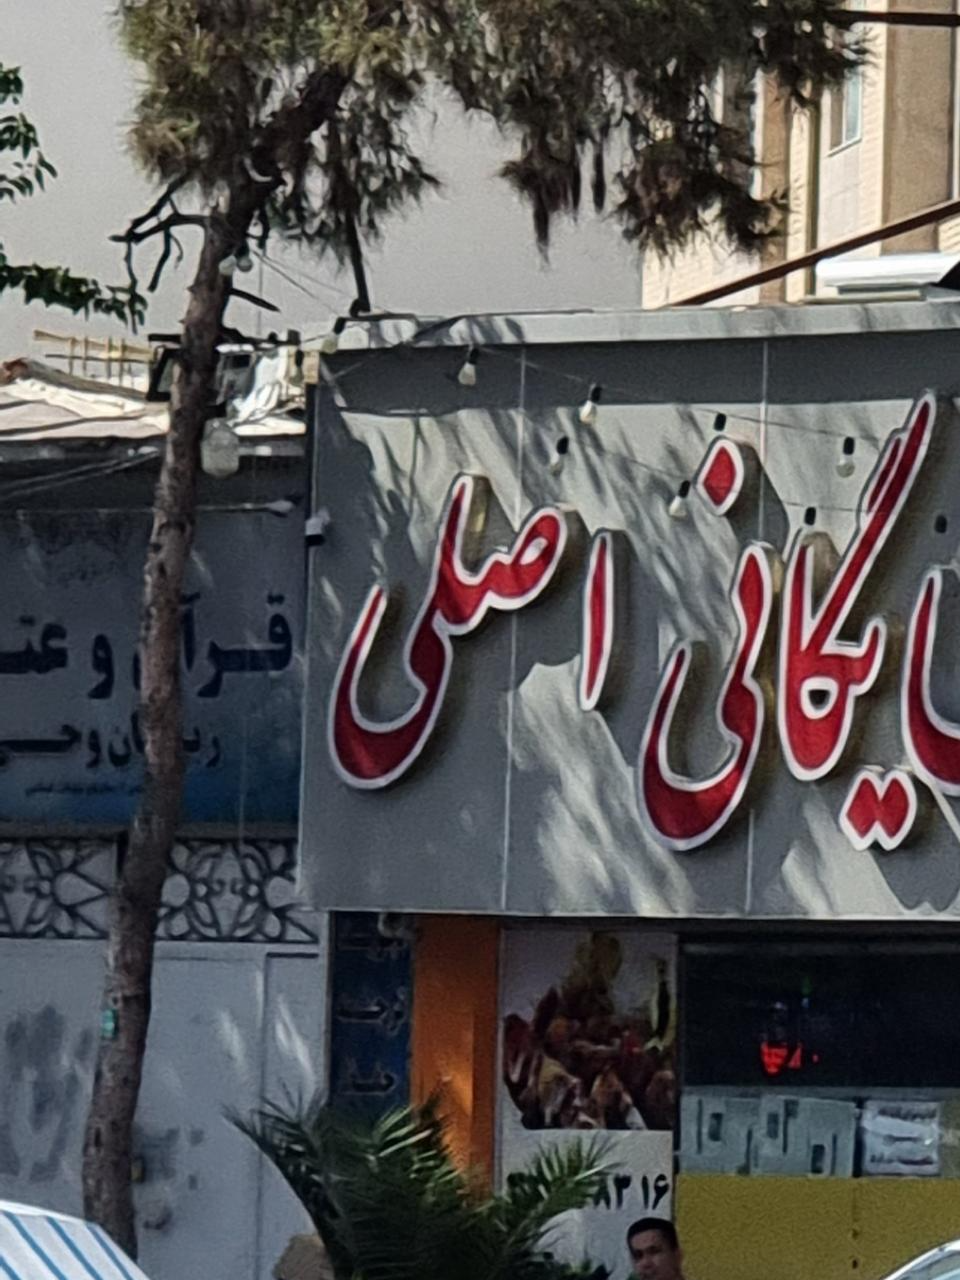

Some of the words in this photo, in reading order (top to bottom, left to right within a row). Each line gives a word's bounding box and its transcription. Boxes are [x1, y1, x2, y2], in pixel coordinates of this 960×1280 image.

[86, 633, 115, 699] و
[132, 591, 293, 699] قرآ
[327, 472, 614, 790] اصلی
